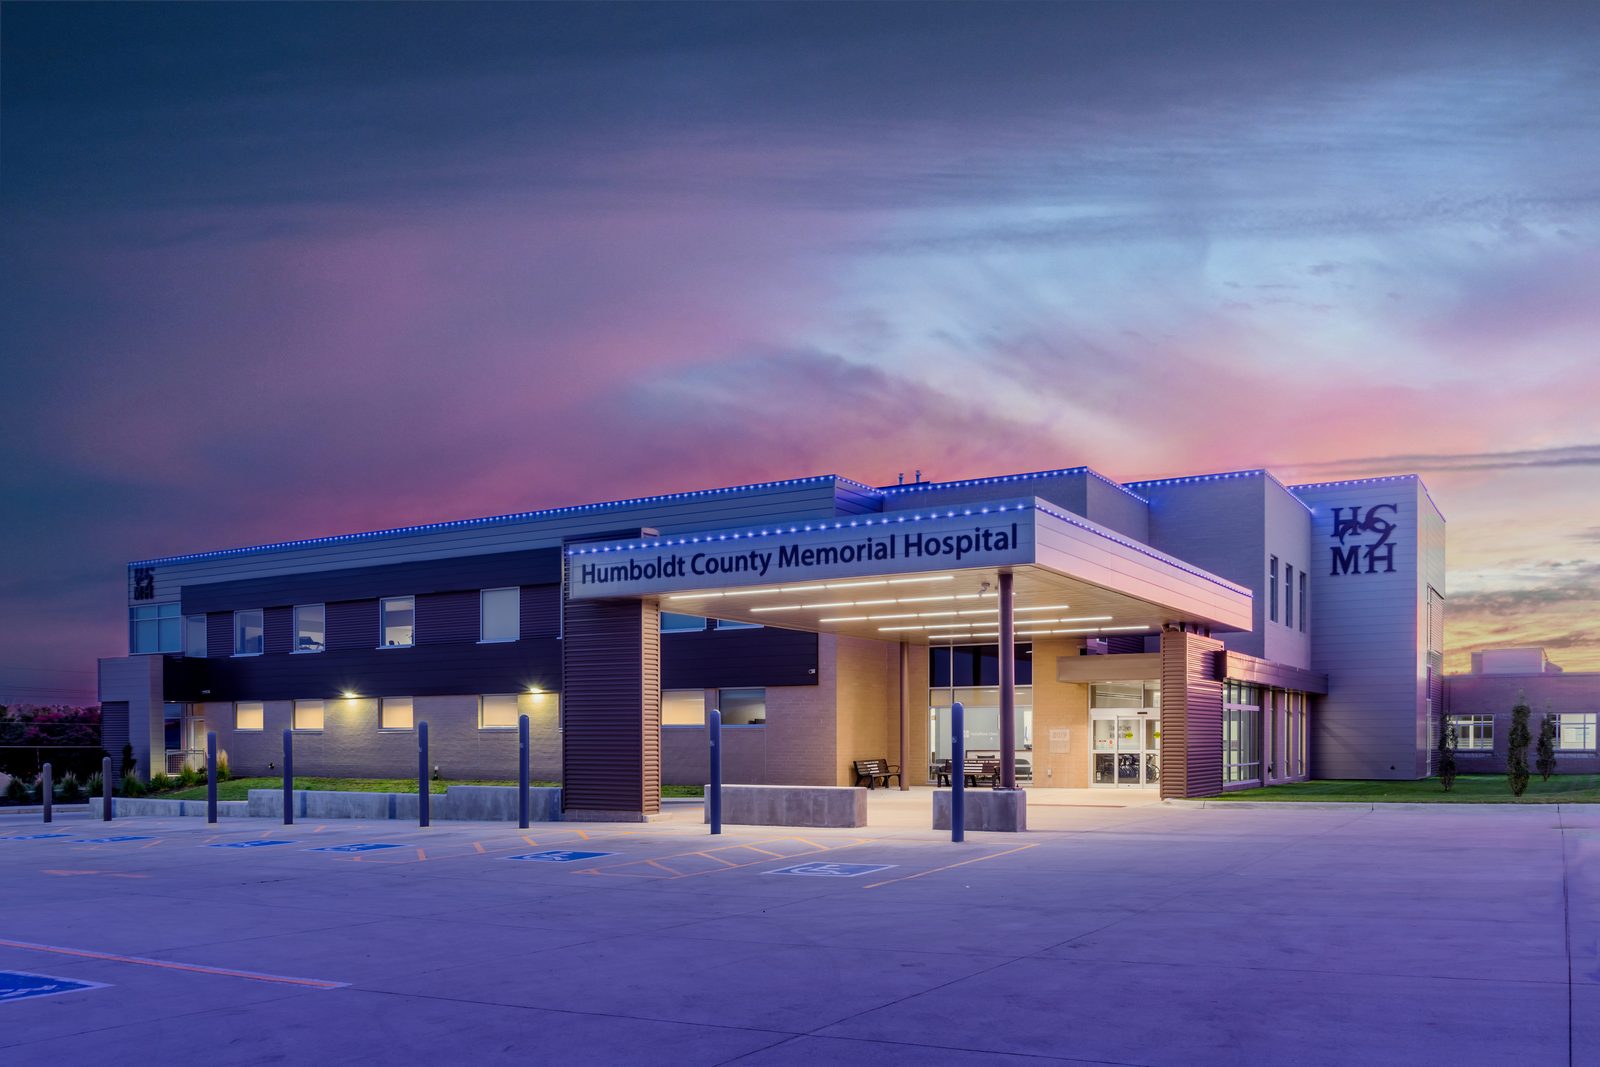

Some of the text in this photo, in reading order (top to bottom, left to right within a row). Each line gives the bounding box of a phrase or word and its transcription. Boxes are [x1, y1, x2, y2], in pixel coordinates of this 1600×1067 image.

[582, 523, 1017, 584] Humboldt County Memorial Hospital
[1329, 543, 1397, 576] MH
